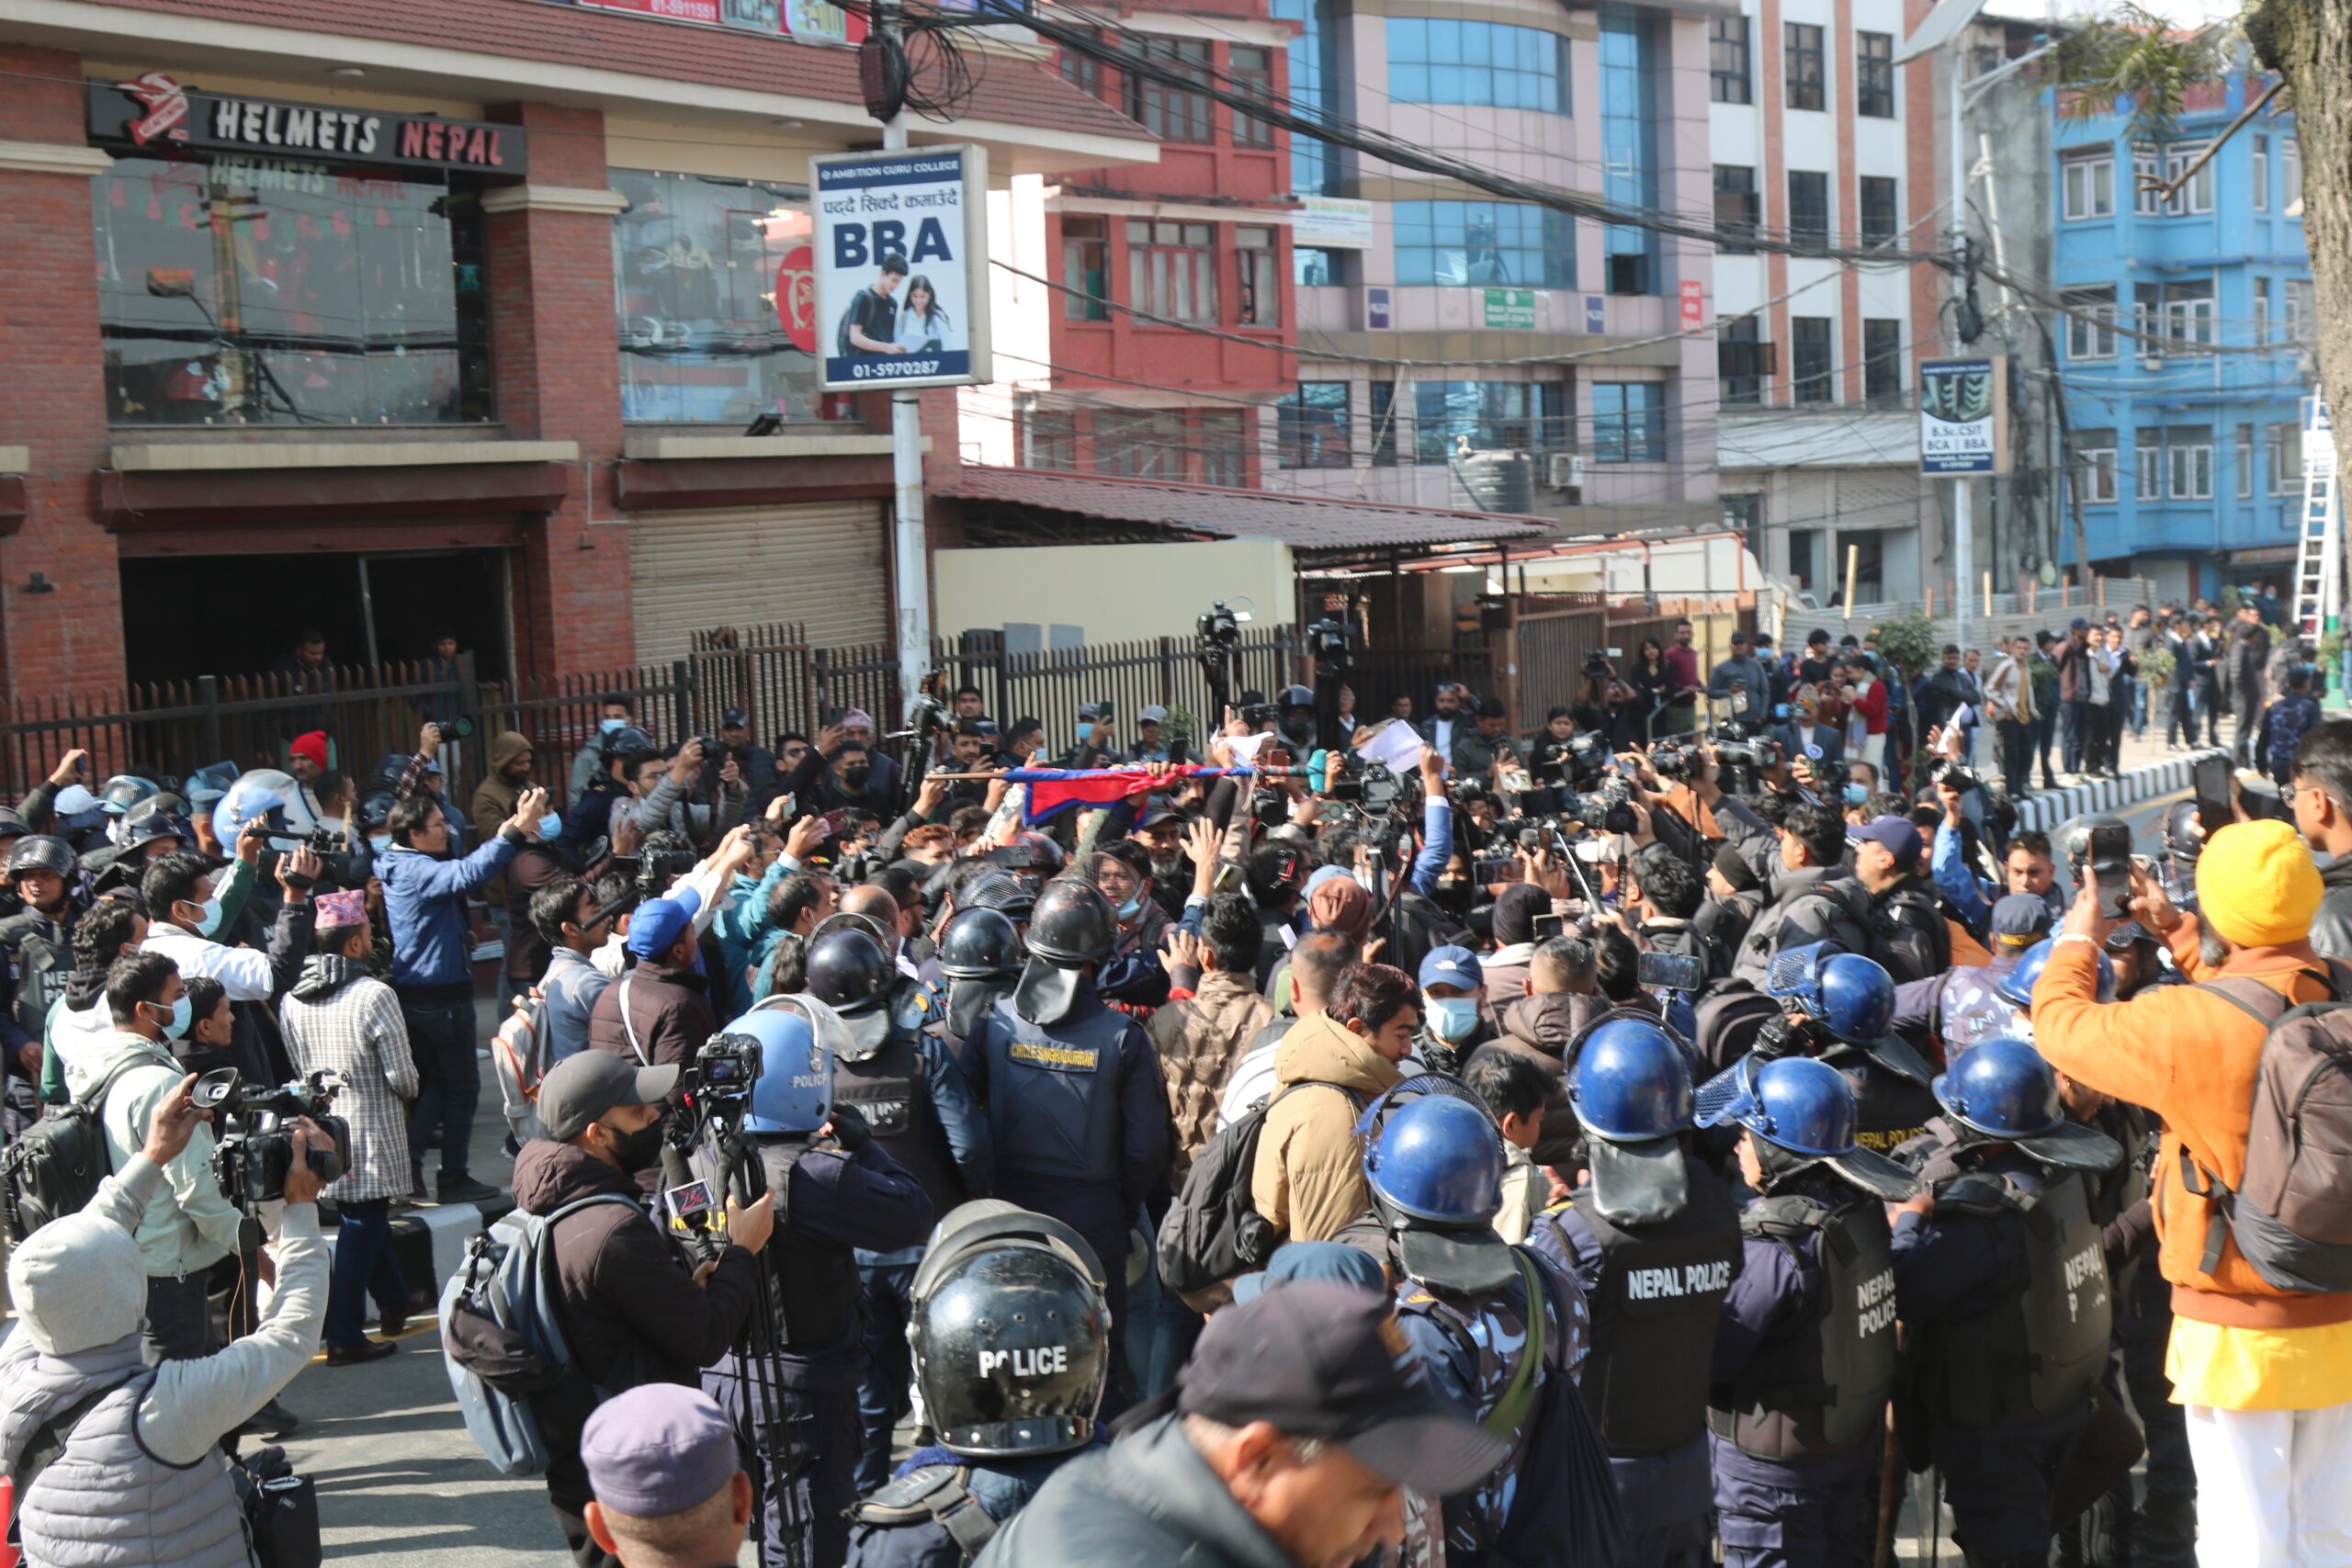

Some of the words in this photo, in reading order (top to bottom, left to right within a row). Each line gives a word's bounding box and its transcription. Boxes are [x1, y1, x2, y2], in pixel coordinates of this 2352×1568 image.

[217, 100, 380, 154] HELMETS
[402, 120, 503, 167] NEPAL
[831, 166, 882, 179] AMBITION
[882, 164, 912, 175] GURU
[913, 160, 960, 173] COLLEGE
[833, 217, 953, 268] BBA
[853, 360, 940, 378] 01-5970287
[1928, 440, 1950, 450] BCA
[1964, 438, 1988, 448] BBA
[858, 1102, 902, 1126] OLIC
[1627, 1267, 1683, 1300] NEPAL
[1685, 1260, 1731, 1294] POLICE
[2064, 1243, 2103, 1292] NEPAL
[1857, 1267, 1895, 1310] NEPAL
[1859, 1294, 1896, 1338] POLICE
